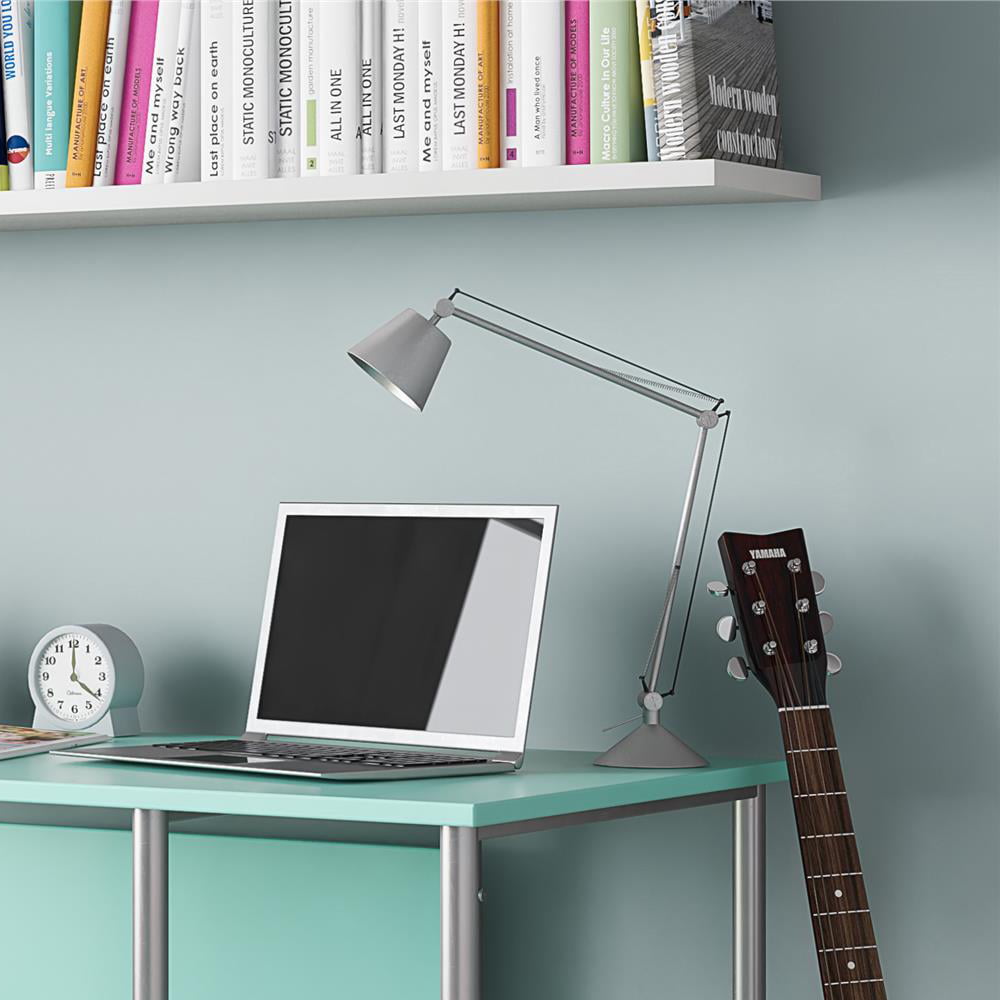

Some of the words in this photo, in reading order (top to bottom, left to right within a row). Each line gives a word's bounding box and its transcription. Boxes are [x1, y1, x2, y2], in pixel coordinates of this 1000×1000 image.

[1, 14, 14, 38] YOU
[393, 28, 405, 42] H!
[454, 23, 465, 37] H!
[600, 27, 610, 45] Life
[3, 39, 16, 80] WORLD
[209, 41, 218, 77] earth
[242, 0, 255, 98] MONOCULTURE
[601, 48, 610, 67] Our
[45, 52, 53, 96] Variations
[175, 47, 184, 85] back
[362, 58, 372, 88] ONE
[393, 45, 405, 103] MONDAY
[422, 40, 432, 93] myself
[454, 41, 465, 99] MONDAY
[570, 58, 577, 70] OF
[602, 70, 610, 80] In
[152, 57, 164, 107] myself
[211, 82, 218, 100] on
[330, 69, 342, 97] ONE
[708, 74, 742, 110] Modern
[743, 85, 777, 116] wooden
[96, 103, 108, 144] place
[102, 79, 111, 97] on
[171, 91, 182, 120] way
[279, 87, 292, 136] STATIC
[330, 101, 342, 114] IN
[362, 93, 372, 107] IN
[601, 84, 610, 122] Culture
[45, 100, 55, 130] langue
[72, 99, 84, 160] MANUFACTURE
[78, 85, 85, 96] OF
[126, 110, 137, 163] MANUFACTURE
[132, 68, 141, 96] MODELS
[149, 113, 159, 144] and
[209, 105, 220, 145] place
[242, 103, 254, 145] STATIC
[362, 111, 372, 136] ALL
[393, 107, 405, 139] LAST
[422, 99, 431, 131] and
[454, 103, 465, 135] LAST
[330, 118, 342, 141] ALL
[602, 125, 610, 160] Macro
[45, 133, 53, 155] Multi
[165, 127, 179, 173] Wrong
[423, 136, 431, 162] Me
[717, 128, 777, 160] constructions
[146, 149, 155, 174] Me
[209, 150, 218, 176] Last
[749, 548, 786, 559] YAMAHA
[55, 644, 64, 653] 11
[68, 639, 79, 649] 12
[86, 645, 90, 653] 1
[45, 656, 56, 665] 10
[94, 656, 102, 665] 2
[42, 672, 49, 681] 9
[98, 672, 106, 681] 3
[47, 688, 54, 697] 8
[57, 700, 64, 709] 7
[85, 701, 92, 709] 5
[72, 705, 78, 714] 6
